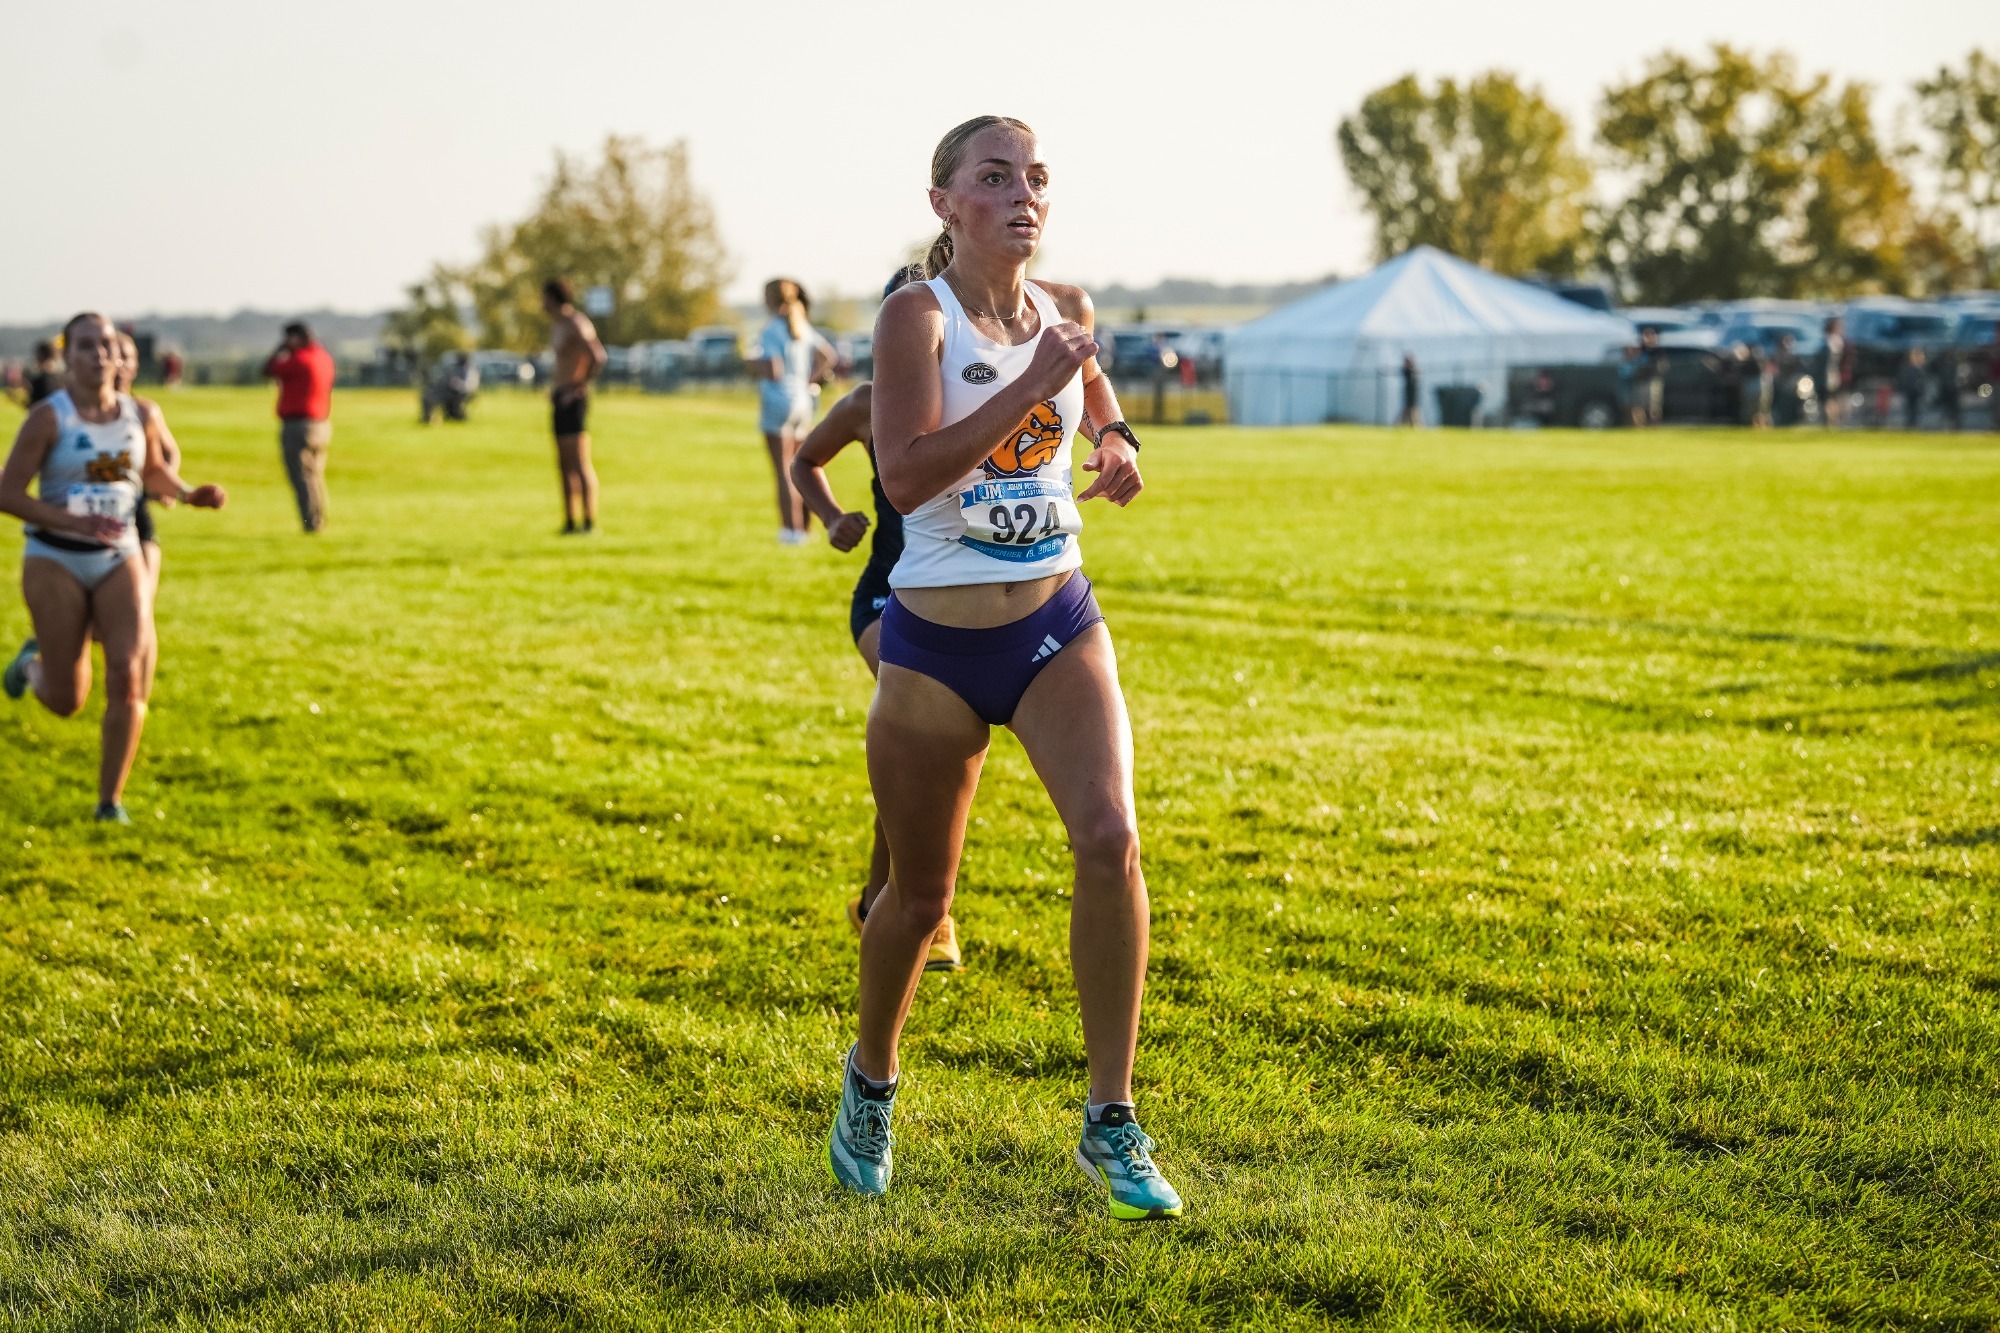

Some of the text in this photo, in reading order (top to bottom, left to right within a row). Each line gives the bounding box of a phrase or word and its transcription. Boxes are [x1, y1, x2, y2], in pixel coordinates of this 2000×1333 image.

[970, 369, 990, 378] OVC
[981, 484, 1003, 500] JM
[989, 502, 1060, 544] 924
